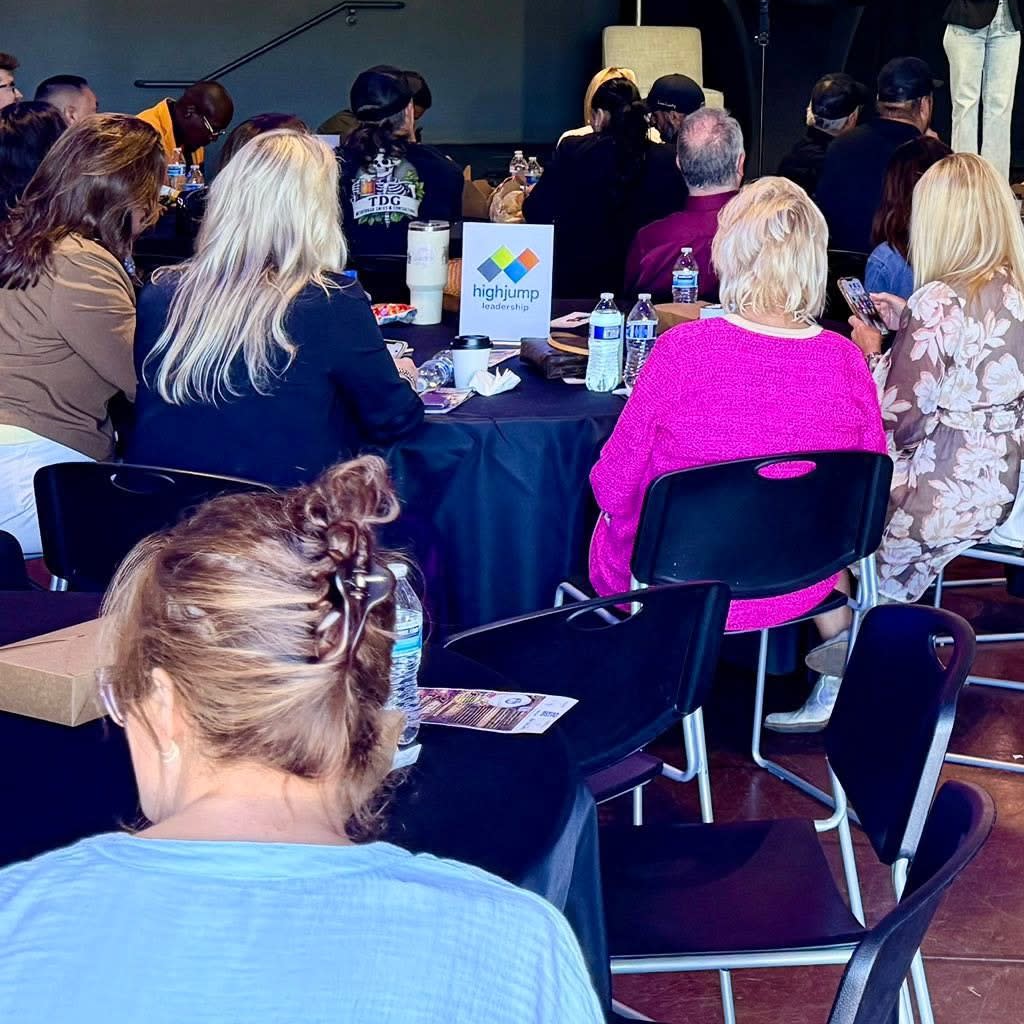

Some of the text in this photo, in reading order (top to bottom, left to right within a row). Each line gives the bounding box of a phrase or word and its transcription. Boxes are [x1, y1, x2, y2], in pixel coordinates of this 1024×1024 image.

[368, 195, 401, 207] TDG
[472, 283, 540, 303] highjump
[481, 302, 529, 312] leadership
